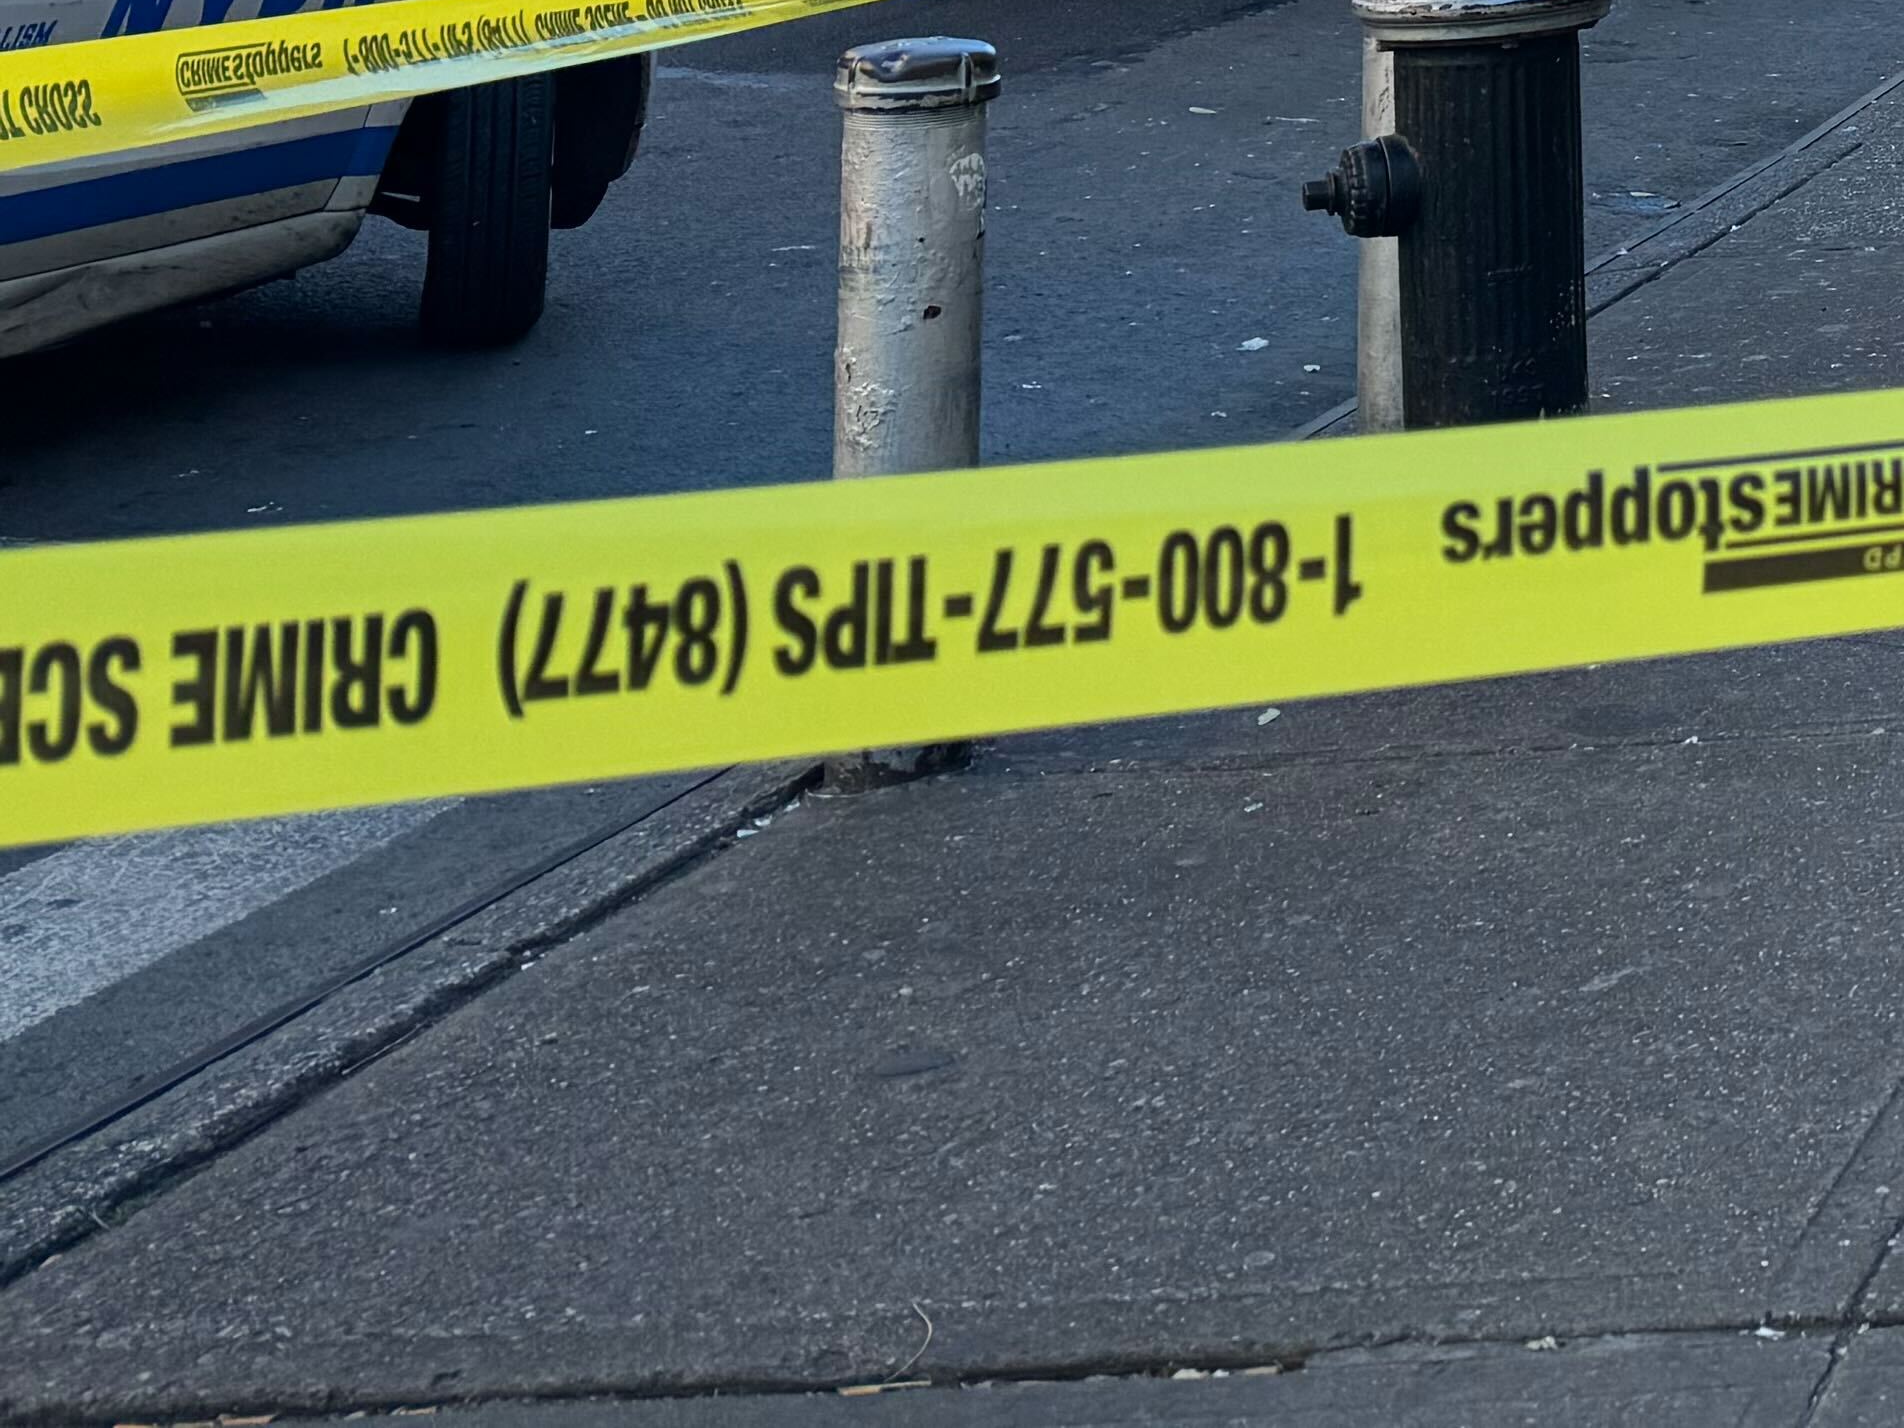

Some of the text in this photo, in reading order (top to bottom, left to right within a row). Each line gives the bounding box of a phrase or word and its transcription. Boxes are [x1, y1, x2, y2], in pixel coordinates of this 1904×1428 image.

[169, 513, 1363, 748] 1-800-577-TIPS (8477) CRIME
